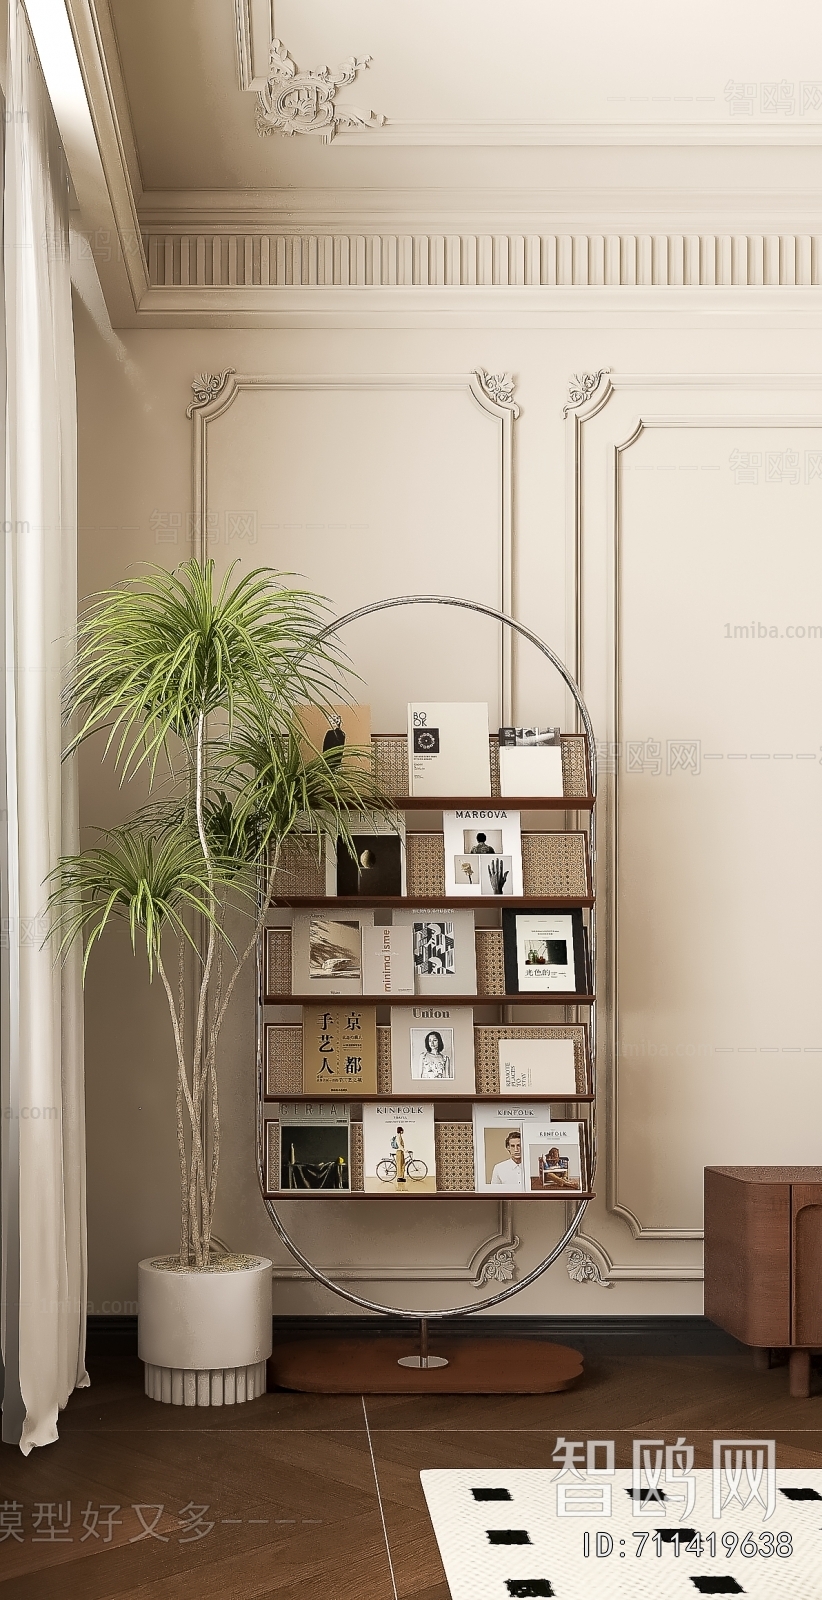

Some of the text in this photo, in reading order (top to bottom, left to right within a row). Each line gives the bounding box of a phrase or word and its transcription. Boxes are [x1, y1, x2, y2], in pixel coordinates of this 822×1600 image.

[455, 810, 508, 819] MARGOVA
[412, 1007, 451, 1019] Union
[316, 1012, 335, 1075] 手艺人
[280, 1104, 349, 1115] CEREAL
